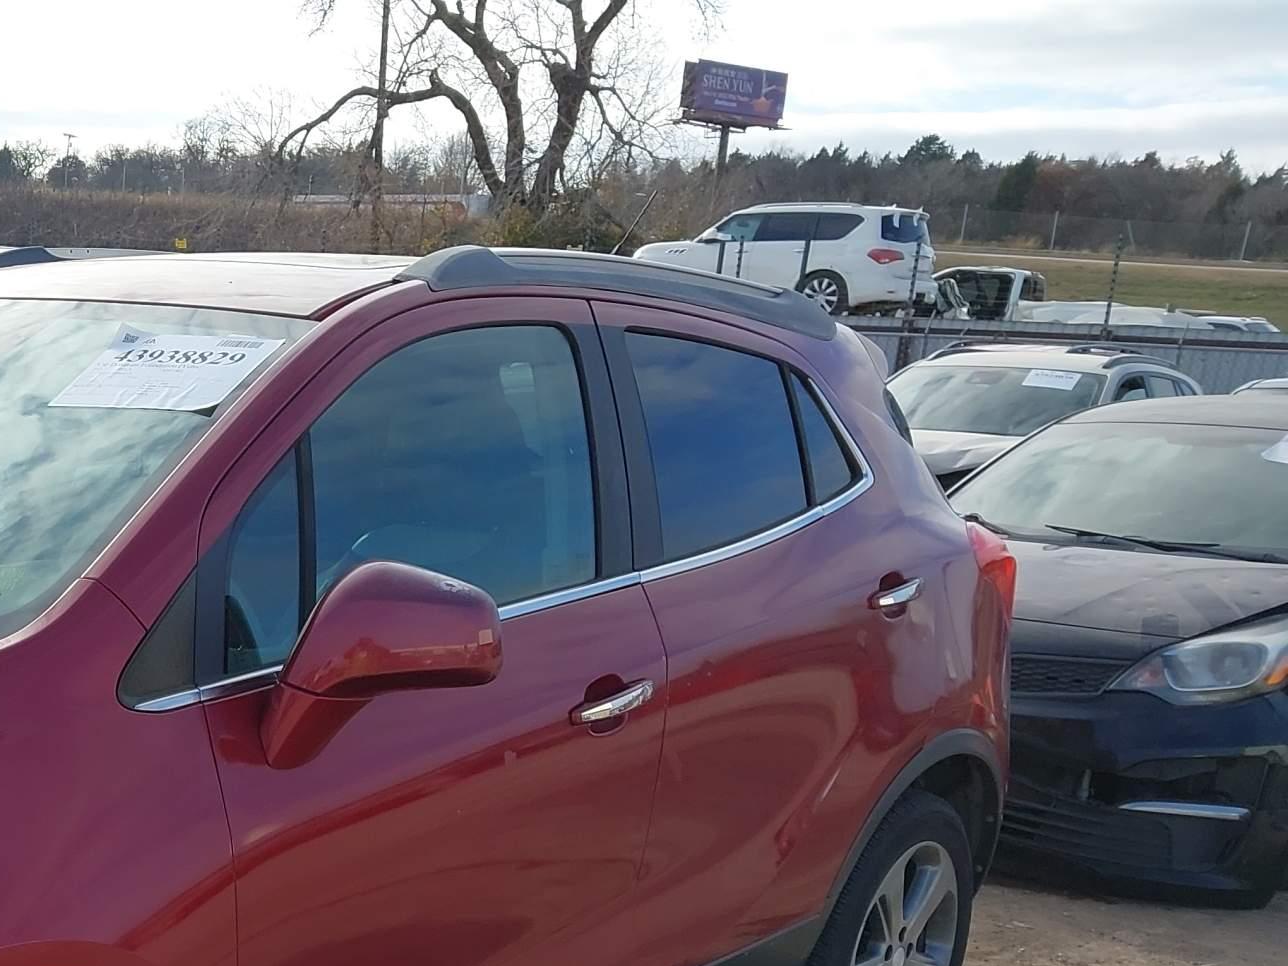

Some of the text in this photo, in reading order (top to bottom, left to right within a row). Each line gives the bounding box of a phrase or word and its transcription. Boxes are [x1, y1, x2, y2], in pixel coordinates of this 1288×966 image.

[703, 73, 730, 89] SHEN
[732, 78, 754, 94] YUN
[113, 349, 246, 365] 43938829
